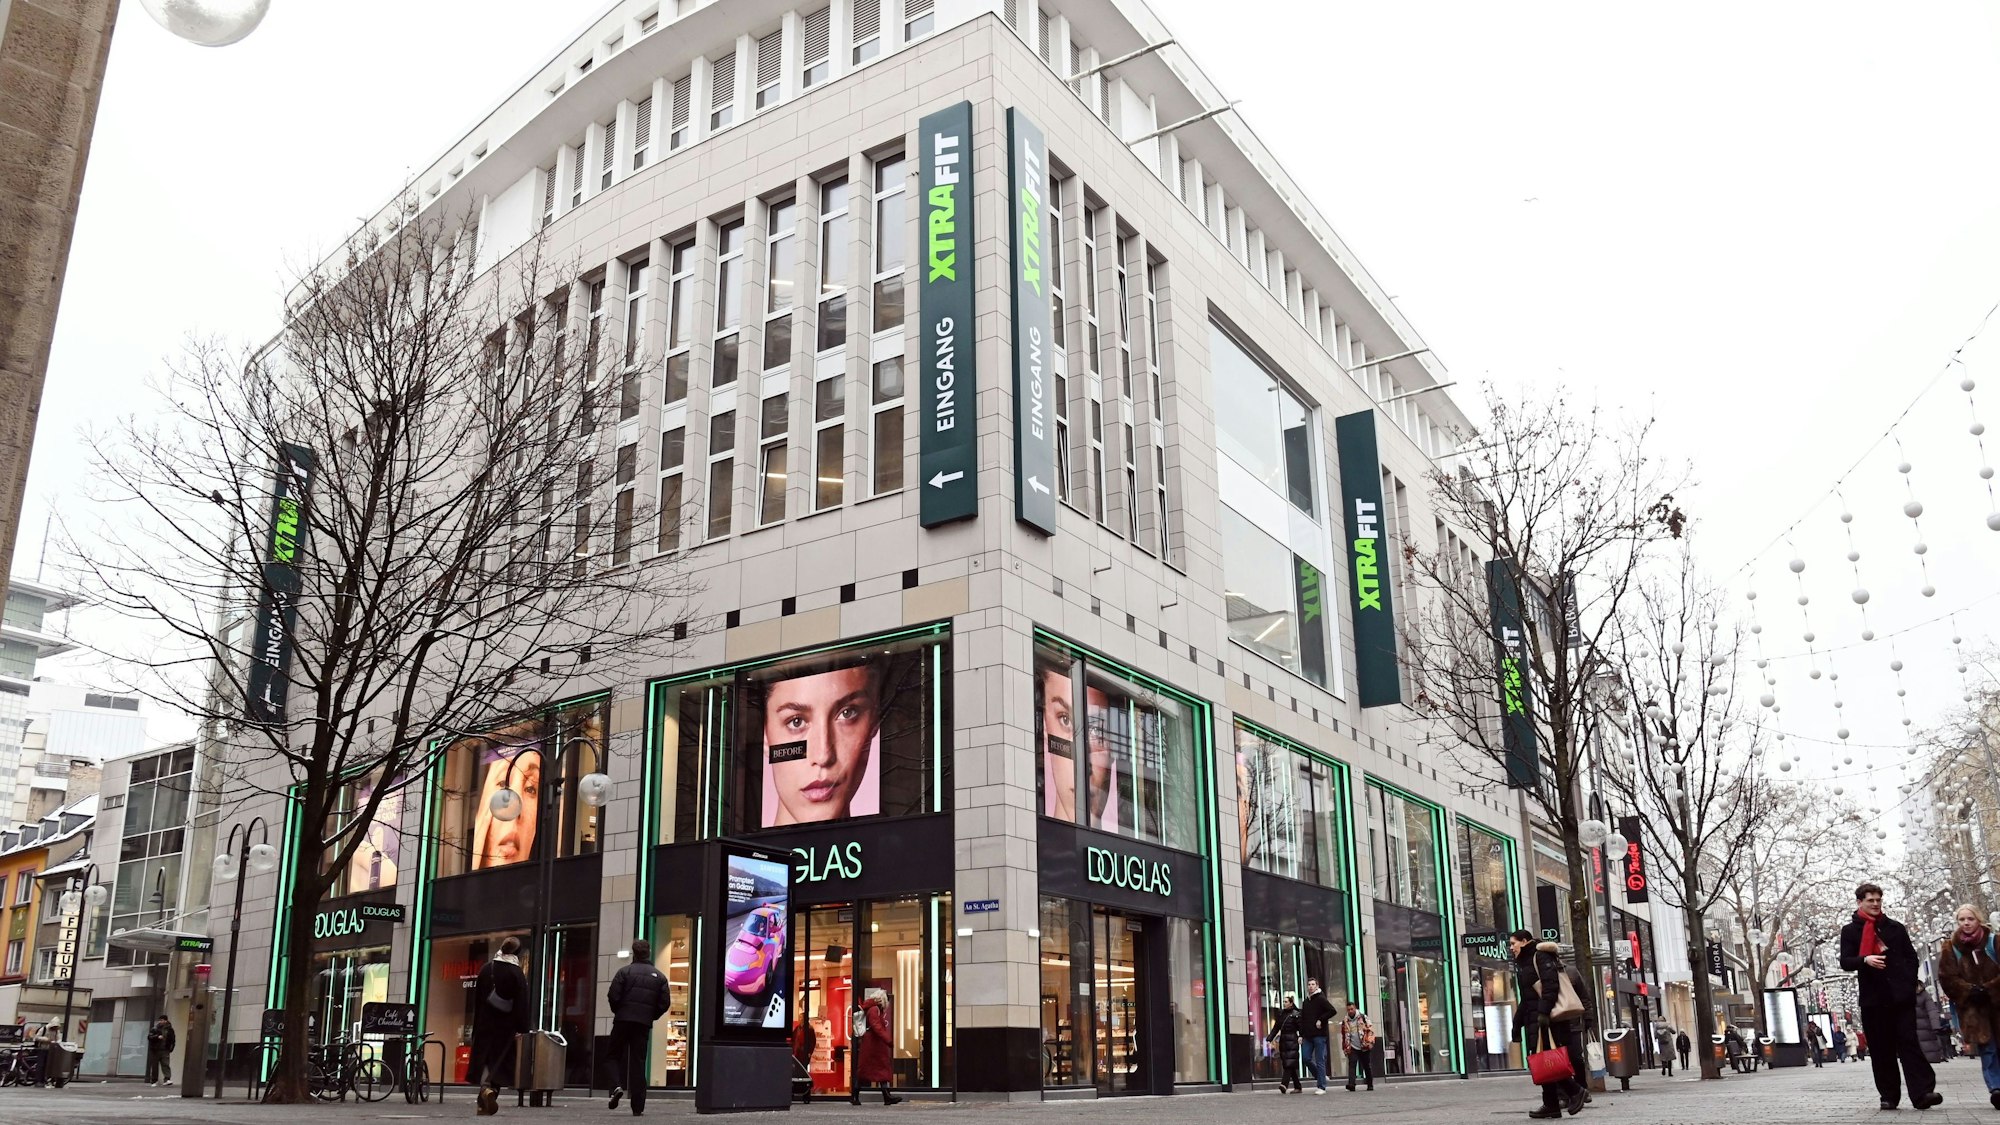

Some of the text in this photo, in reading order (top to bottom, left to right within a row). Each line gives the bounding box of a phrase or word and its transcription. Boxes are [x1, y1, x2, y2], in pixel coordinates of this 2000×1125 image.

[929, 133, 959, 283] XTRAFIT
[1022, 138, 1040, 298] XTRAFIT
[936, 317, 954, 432] EINGANG
[1030, 326, 1043, 440] EINGANG
[1354, 498, 1381, 611] XTRAFIT
[773, 746, 803, 758] BEFORE
[729, 875, 754, 885] Prompted
[793, 841, 862, 883] GLAS
[1087, 846, 1171, 897] DOUGLAS
[736, 882, 754, 893] Galaxy
[363, 906, 401, 917] DOUGLAS
[981, 901, 999, 911] Agatha
[60, 879, 81, 978] CFFEUR
[181, 940, 210, 949] XTRAFIT
[1465, 935, 1495, 944] DOUGLAS
[1712, 943, 1721, 974] PHORA
